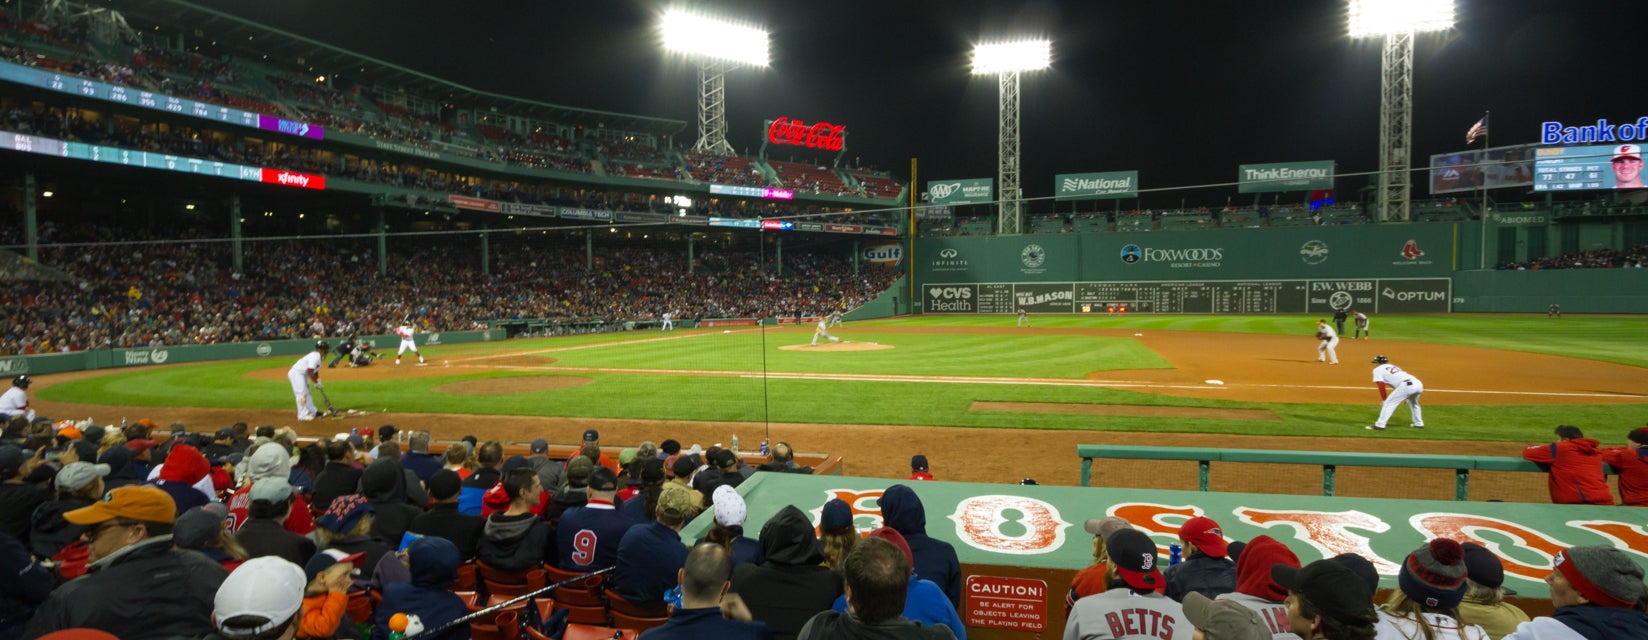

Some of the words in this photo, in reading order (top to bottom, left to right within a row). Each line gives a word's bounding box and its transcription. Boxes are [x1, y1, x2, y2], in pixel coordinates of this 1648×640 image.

[1542, 119, 1616, 145] Bank
[1618, 116, 1648, 141] of
[243, 168, 260, 178] 6TH
[278, 173, 309, 187] xfinity
[1078, 177, 1131, 190] National
[1501, 216, 1545, 224] ABIOMED
[864, 248, 900, 259] Gulf
[1144, 248, 1224, 261] FOXWOODS
[1336, 282, 1372, 291] WEBB
[943, 287, 972, 299] CVS
[1397, 292, 1445, 301] OPTUM
[931, 300, 972, 311] Health
[572, 529, 597, 566] 9
[1142, 553, 1153, 570] B
[971, 583, 1043, 597] CAUTION!
[973, 609, 1007, 617] OBJECTS
[1009, 612, 1040, 620] LEAVING
[988, 619, 1018, 628] PLAYING
[1021, 621, 1043, 629] FIELD
[1105, 608, 1175, 640] BETTS
